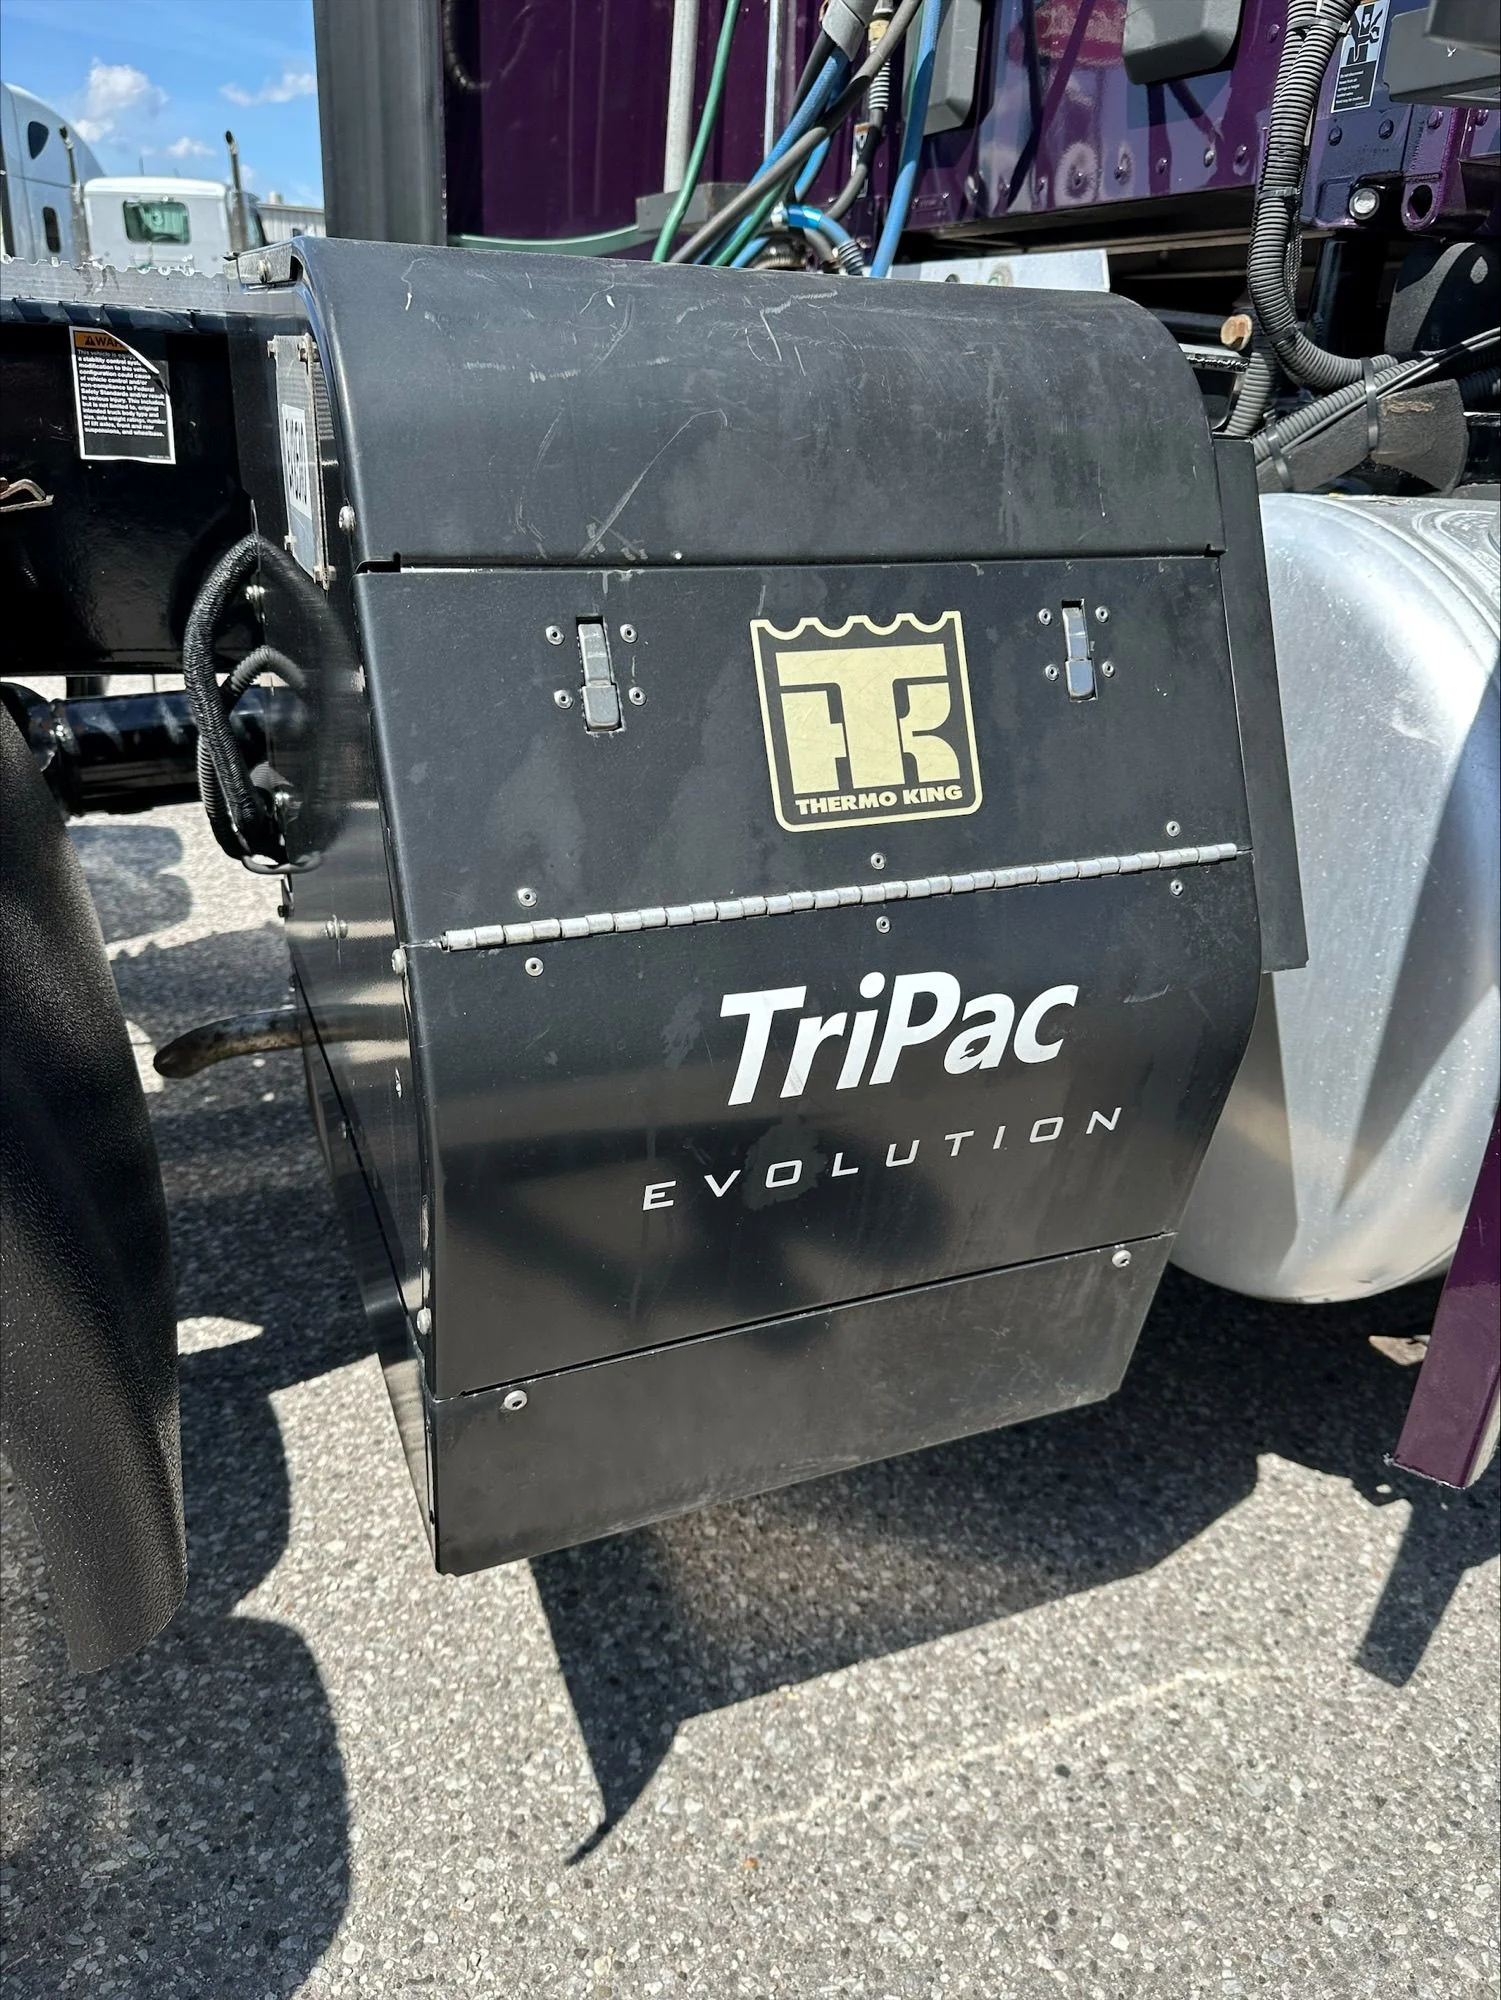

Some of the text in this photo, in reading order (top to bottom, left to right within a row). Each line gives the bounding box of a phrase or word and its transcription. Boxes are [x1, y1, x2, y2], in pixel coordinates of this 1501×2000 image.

[795, 784, 963, 816] THERMO KING
[719, 971, 1080, 1106] TriPac
[642, 1106, 1123, 1211] EVOLUTION
